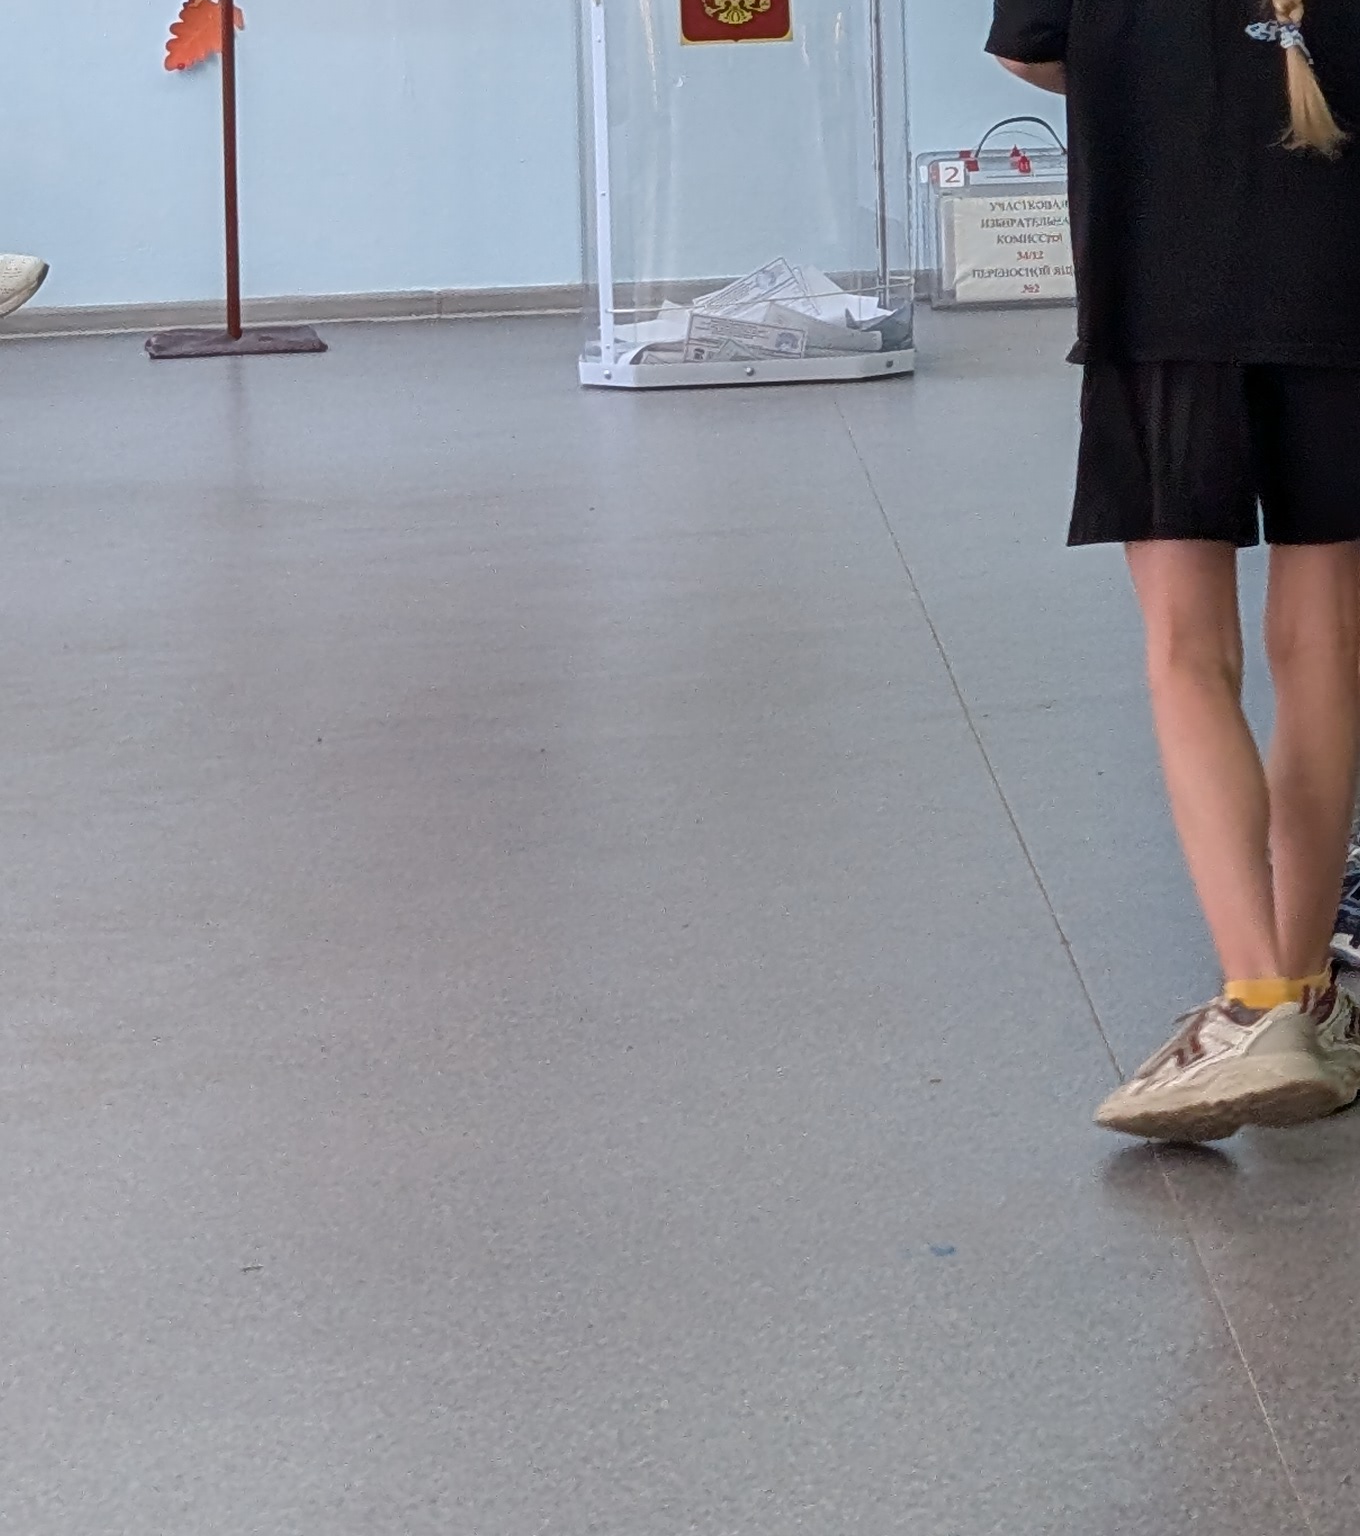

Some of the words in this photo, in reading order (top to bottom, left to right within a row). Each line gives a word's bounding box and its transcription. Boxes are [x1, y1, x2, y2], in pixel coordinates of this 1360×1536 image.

[944, 166, 960, 183] 2
[980, 217, 1070, 229] ИЗБИРАТЕЛЬНА
[1052, 265, 1074, 278] ЯЩ
